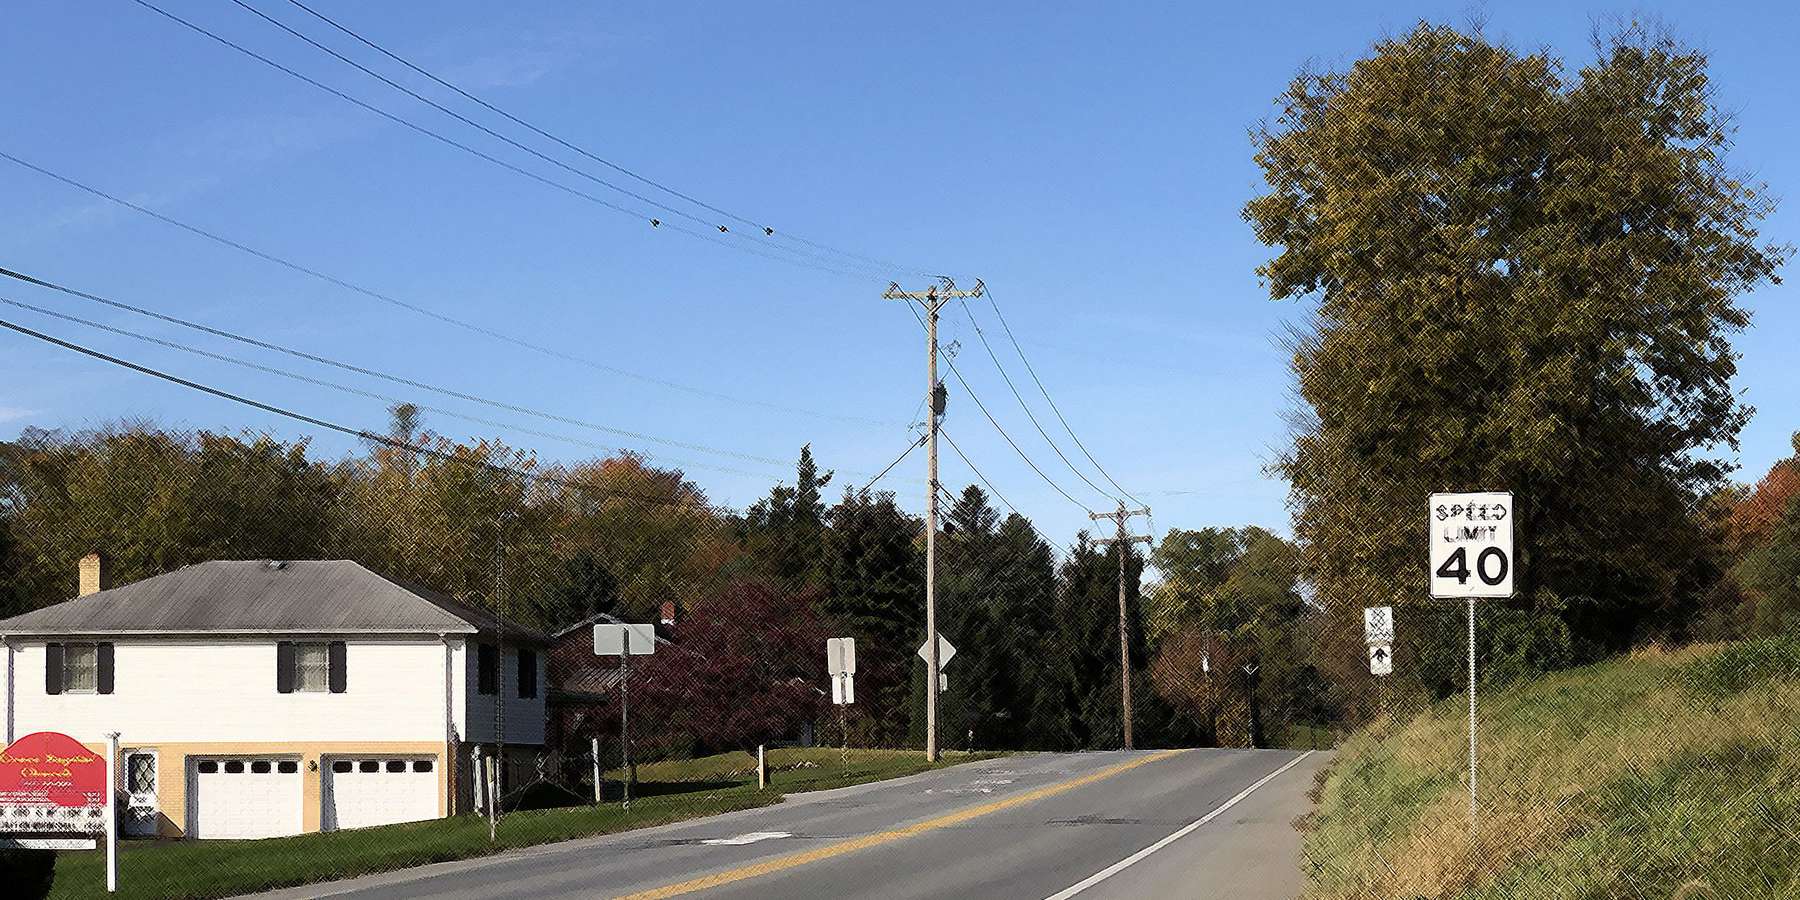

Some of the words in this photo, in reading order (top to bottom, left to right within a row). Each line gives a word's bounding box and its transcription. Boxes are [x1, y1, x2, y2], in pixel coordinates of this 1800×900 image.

[1436, 504, 1507, 521] SPEED
[1443, 526, 1497, 542] LIMIT
[1436, 546, 1509, 586] 40
